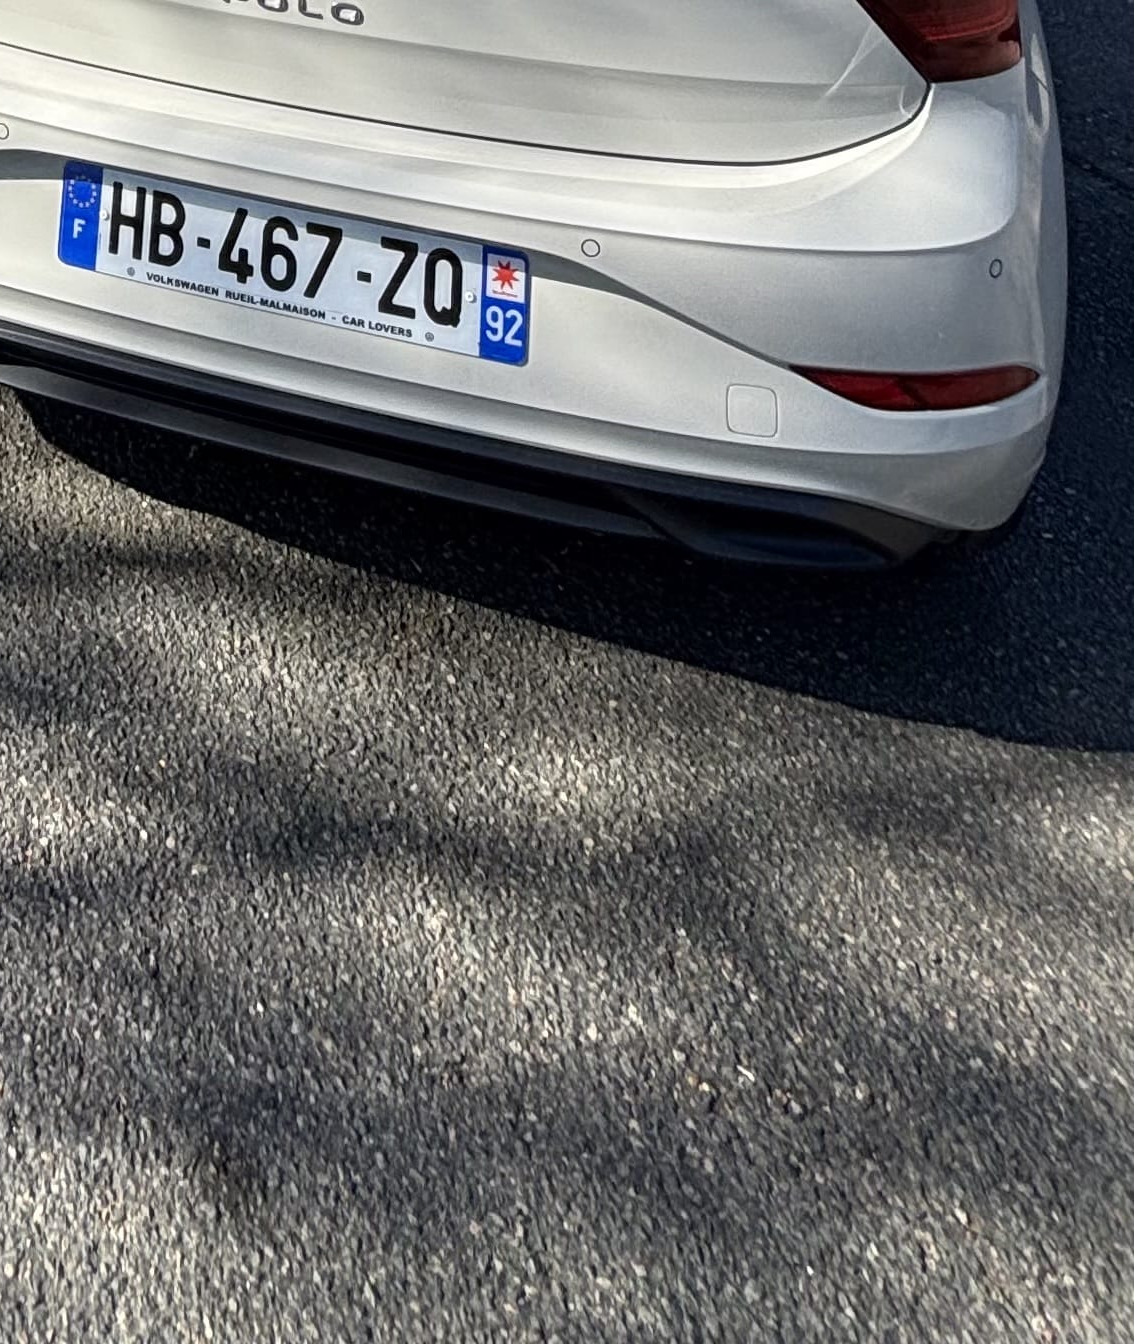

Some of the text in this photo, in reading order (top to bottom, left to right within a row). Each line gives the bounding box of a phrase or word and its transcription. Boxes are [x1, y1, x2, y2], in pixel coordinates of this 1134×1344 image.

[72, 218, 86, 239] F
[108, 181, 463, 328] HB-467-ZQ
[145, 271, 219, 297] VOLKSWAGEN
[225, 290, 326, 320] RUEIL-MALMAISON
[342, 315, 365, 329] CAR
[368, 321, 413, 338] LOVERS
[485, 305, 524, 347] 92
